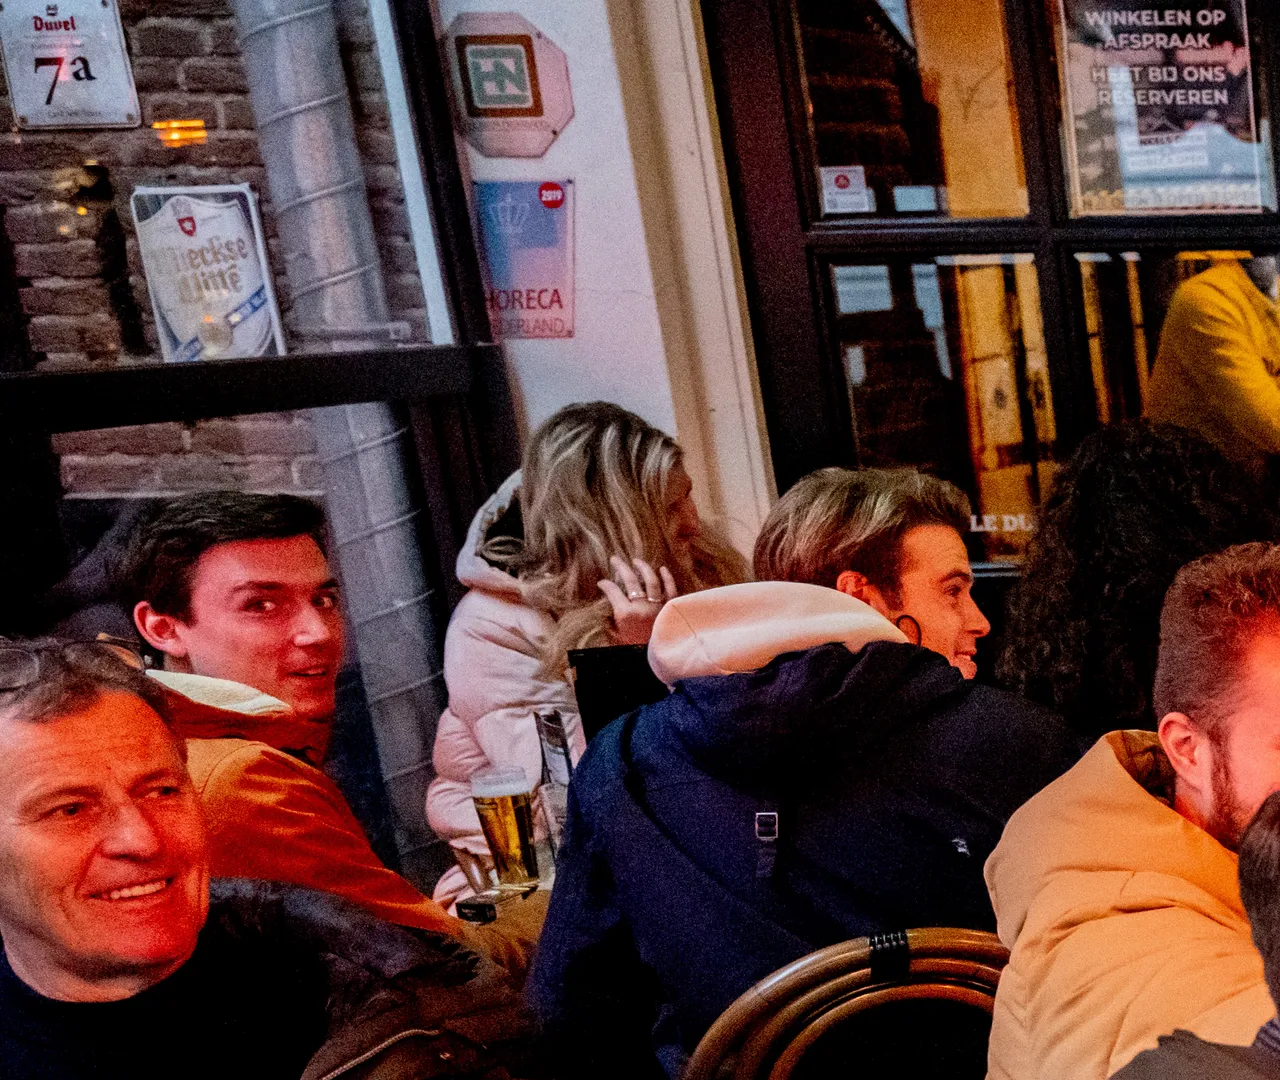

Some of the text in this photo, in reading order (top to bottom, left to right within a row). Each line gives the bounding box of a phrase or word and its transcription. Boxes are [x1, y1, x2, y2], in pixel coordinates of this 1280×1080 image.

[33, 16, 76, 31] Duvel
[1085, 10, 1226, 26] WINKELEN OP
[1103, 33, 1212, 49] AFSPRAAK
[34, 56, 97, 105] 7a
[1148, 66, 1177, 81] BIJ
[1183, 65, 1226, 81] ONS
[541, 189, 563, 201] 2019
[970, 514, 997, 532] LE
